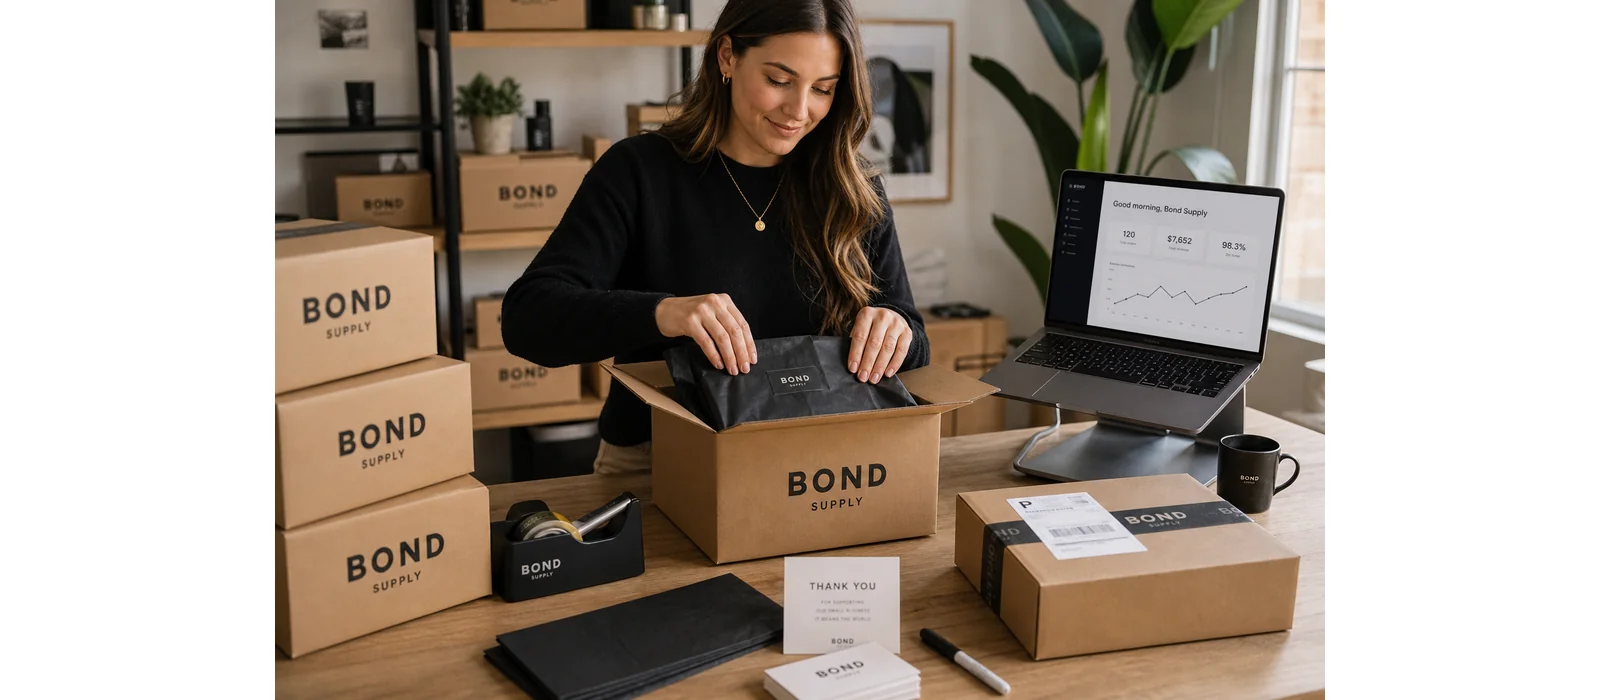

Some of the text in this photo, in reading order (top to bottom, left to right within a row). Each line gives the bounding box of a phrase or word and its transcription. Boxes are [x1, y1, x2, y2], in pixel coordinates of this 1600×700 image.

[498, 185, 558, 201] BOND
[363, 198, 404, 211] BOND
[1113, 200, 1208, 218] Good morning, Bond Supply
[1122, 230, 1136, 239] 120
[1167, 235, 1193, 245] $7,652
[1222, 241, 1246, 252] 98.3%
[302, 284, 391, 325] BOND
[326, 321, 372, 340] SUPPLY
[499, 366, 548, 383] BOND
[780, 374, 810, 384] BOND
[338, 412, 426, 457] BOND
[361, 449, 405, 470] SUPPLY
[788, 463, 887, 497] BOND
[1239, 474, 1260, 482] BOND
[811, 496, 863, 512] SUPPLY
[1018, 500, 1032, 509] P
[1124, 511, 1187, 525] BOND
[1149, 520, 1181, 529] SUPPLY
[346, 532, 445, 583] BOND
[521, 558, 561, 576] BOND
[372, 570, 422, 594] SUPPLY
[531, 572, 553, 581] SUPPLY
[810, 582, 876, 591] THANK YOU
[815, 661, 864, 678] BOND
